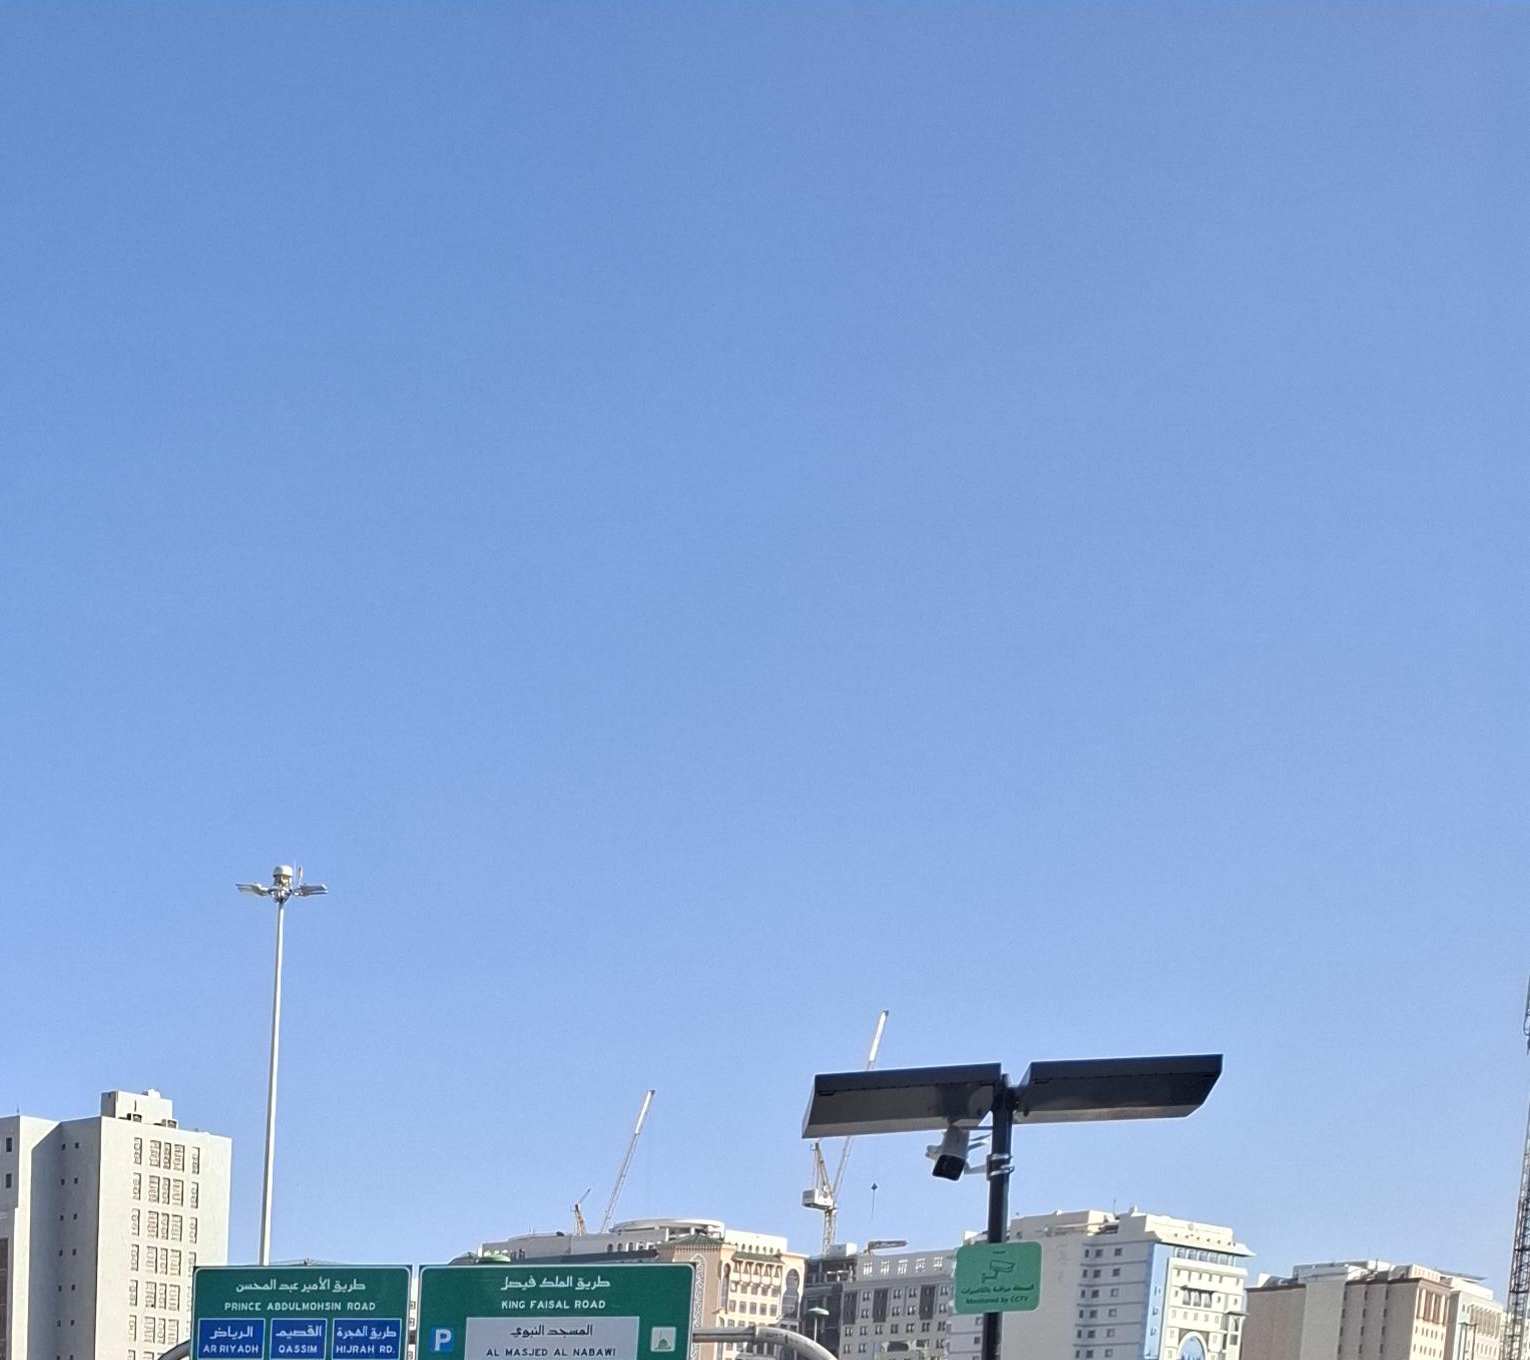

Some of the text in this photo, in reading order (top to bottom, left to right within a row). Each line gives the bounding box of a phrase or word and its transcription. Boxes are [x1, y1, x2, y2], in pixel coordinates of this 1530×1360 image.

[236, 1276, 366, 1293] طريق الأمير عبد المحسن
[501, 1275, 611, 1291] طريق الملك فيصل
[224, 1302, 376, 1311] PRINCE ABDULMOHSIN ROAD
[501, 1300, 606, 1309] KING FAISAL ROAD
[209, 1325, 253, 1340] الرياض
[275, 1324, 322, 1337] القصيم
[336, 1325, 396, 1339] طريق الهجرة
[510, 1324, 593, 1339] المسجد النبوي
[434, 1329, 452, 1351] P
[203, 1345, 259, 1353] AR RIYADH
[278, 1344, 317, 1353] QASSIM
[336, 1345, 396, 1353] HIJRAH RD.
[486, 1347, 616, 1357] AL MASJED AL NABAWI
